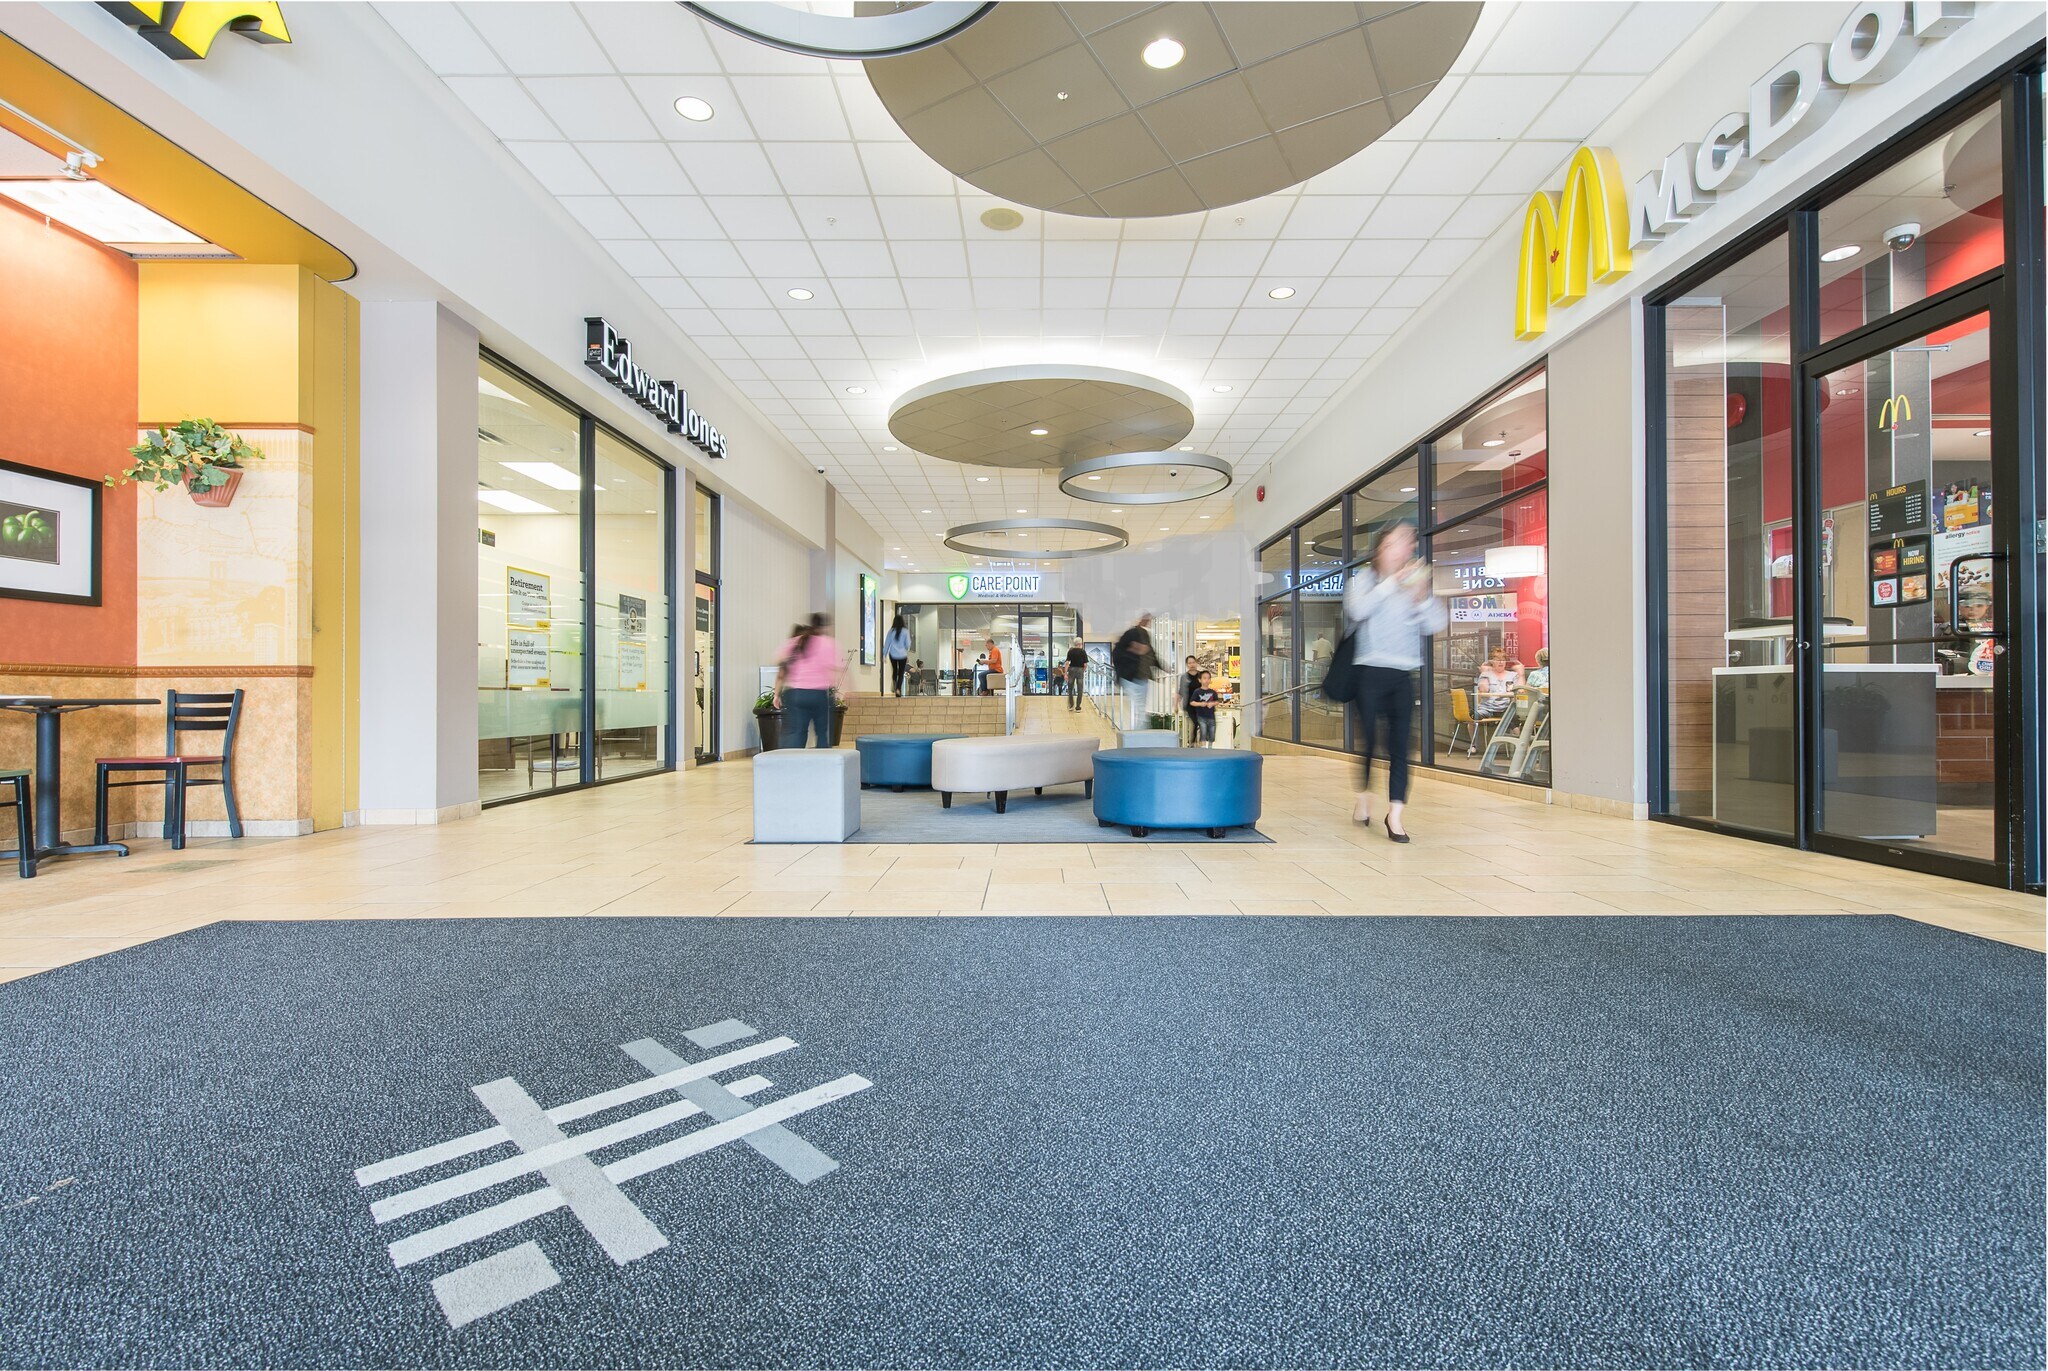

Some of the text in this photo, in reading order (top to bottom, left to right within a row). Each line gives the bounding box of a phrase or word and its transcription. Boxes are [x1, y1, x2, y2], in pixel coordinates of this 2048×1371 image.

[584, 317, 728, 460] Edward Jones
[1886, 485, 1907, 497] HOURS
[1903, 555, 1925, 565] HIRING
[510, 576, 543, 592] Retirement
[972, 576, 1039, 591] CARE POINT
